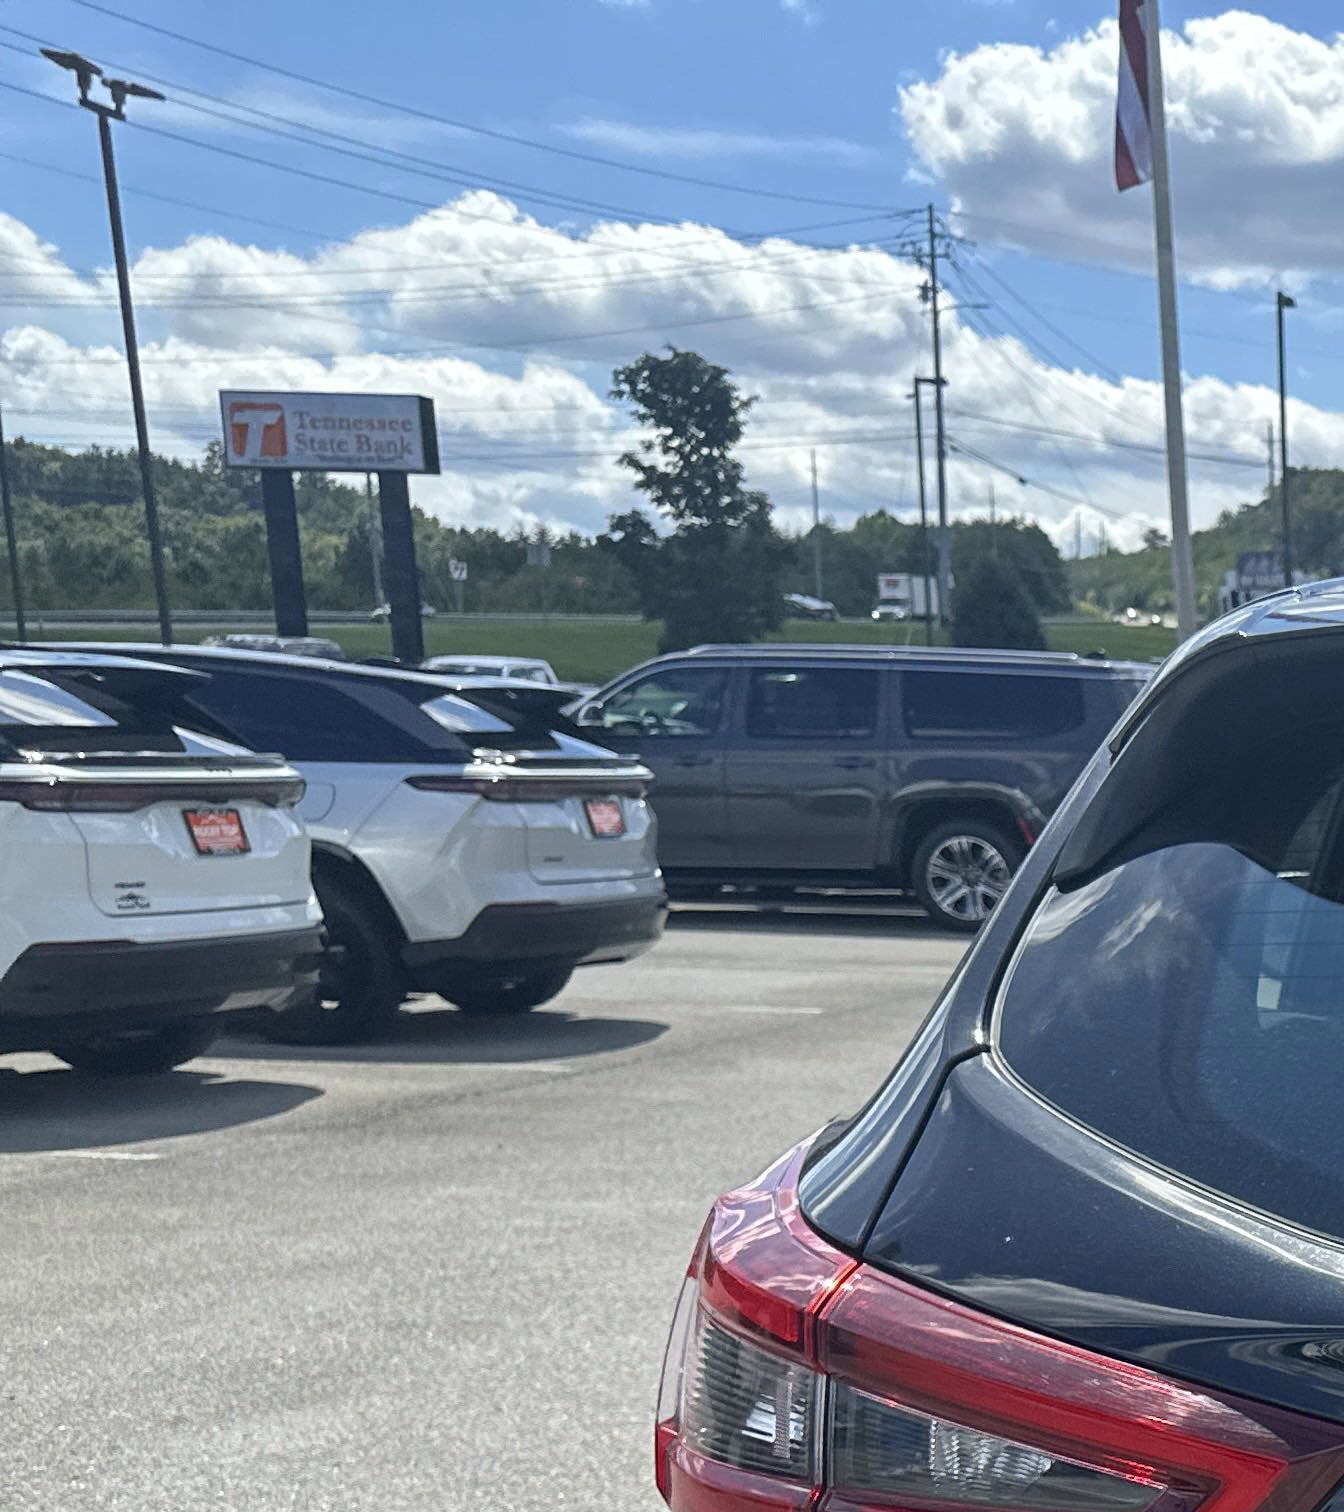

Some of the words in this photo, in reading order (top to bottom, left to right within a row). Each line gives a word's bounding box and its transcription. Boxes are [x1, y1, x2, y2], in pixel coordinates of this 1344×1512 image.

[293, 411, 413, 432] Tennessee
[295, 432, 348, 452] State
[355, 433, 413, 455] Bank
